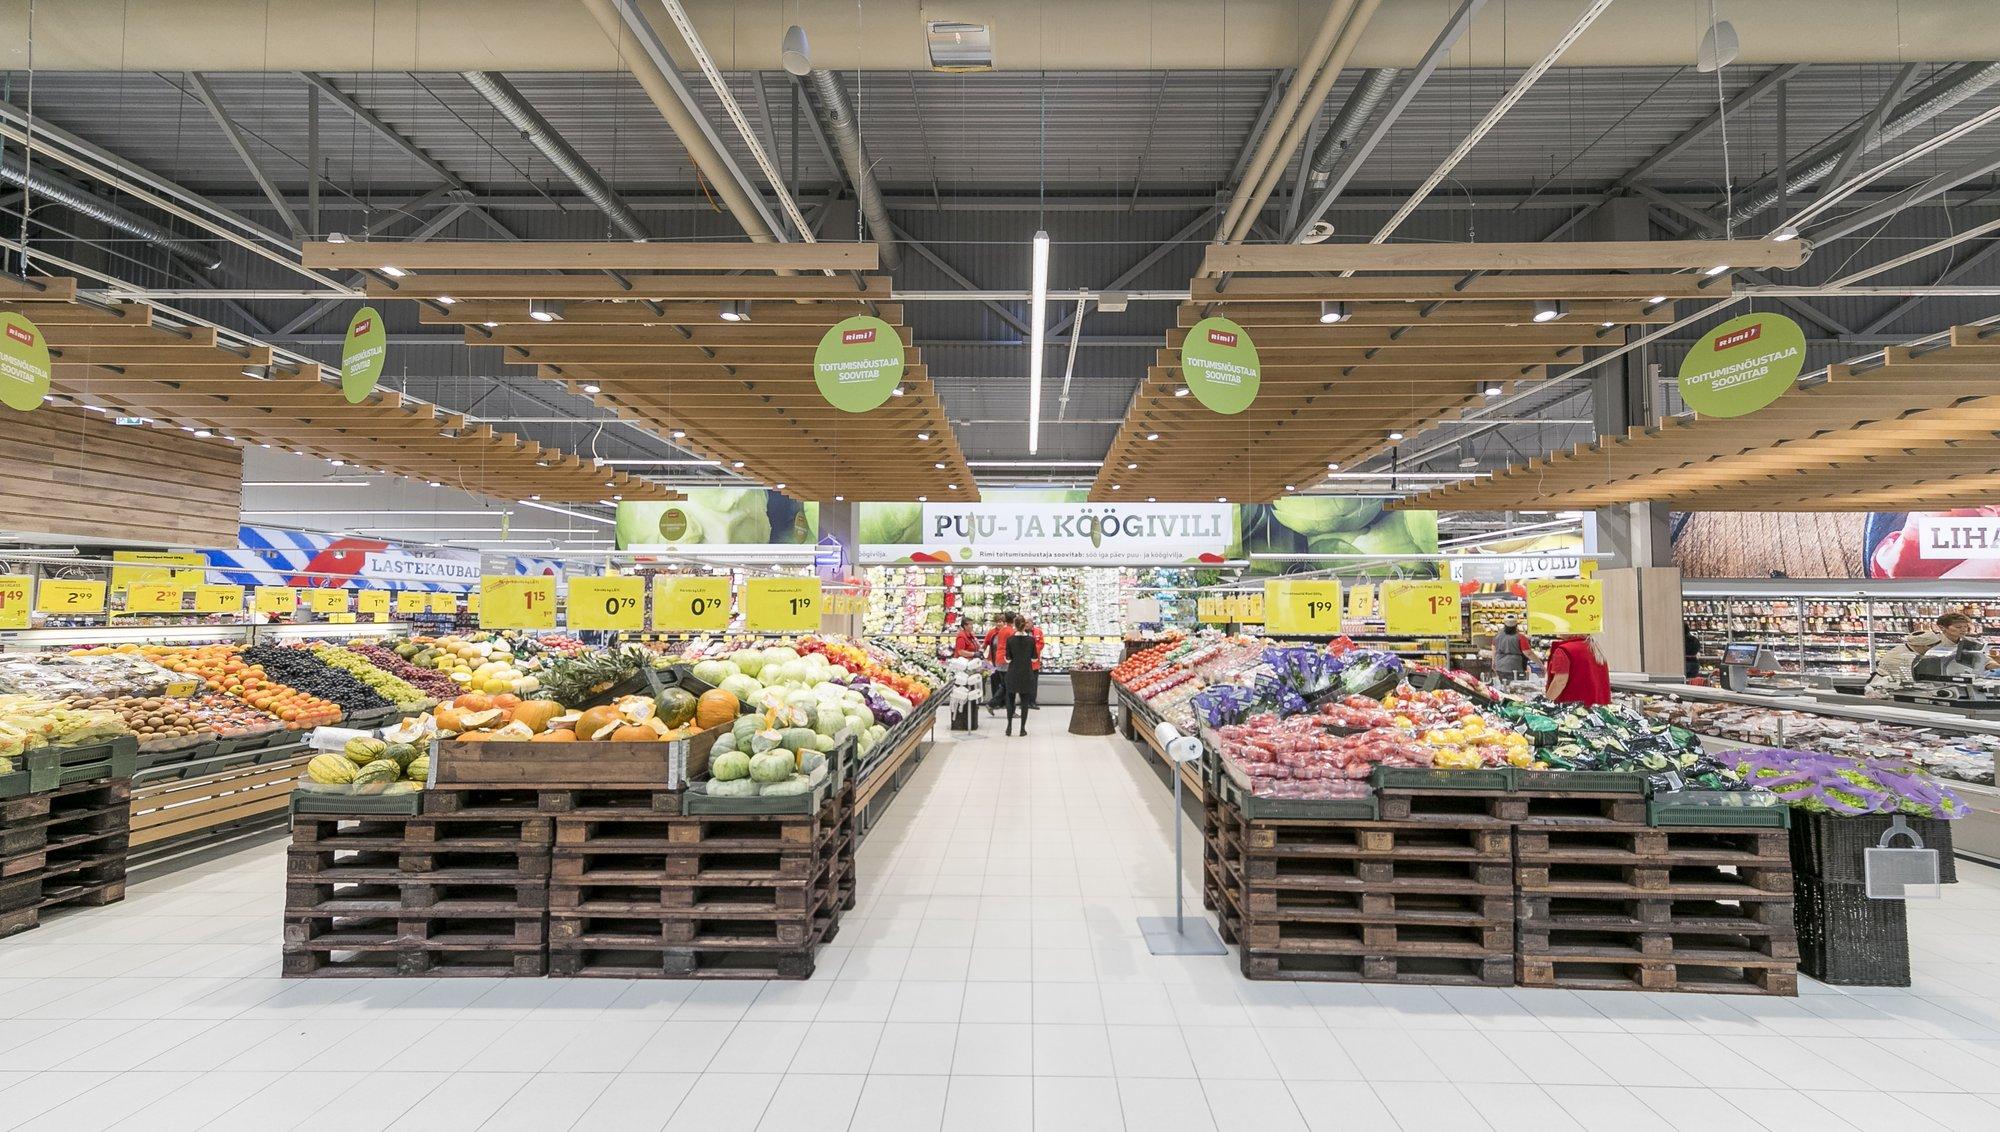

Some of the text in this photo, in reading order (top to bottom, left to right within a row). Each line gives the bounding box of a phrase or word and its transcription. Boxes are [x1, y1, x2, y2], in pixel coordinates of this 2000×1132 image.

[1, 362, 34, 382] SOOVITAB
[819, 357, 899, 372] TOITUMISNÕUSTAJA
[839, 369, 880, 380] SOOVITAB
[1187, 357, 1257, 377] TOITUMISNÕUSTAJA
[1685, 347, 1798, 386] TOITUMISNÕUSTAJA
[1205, 370, 1242, 383] SOOVITAB
[1711, 366, 1769, 389] SOOVITAB
[1053, 508, 1221, 537] KÖÖGIVILI
[372, 559, 481, 578] LASTEKAUBAD
